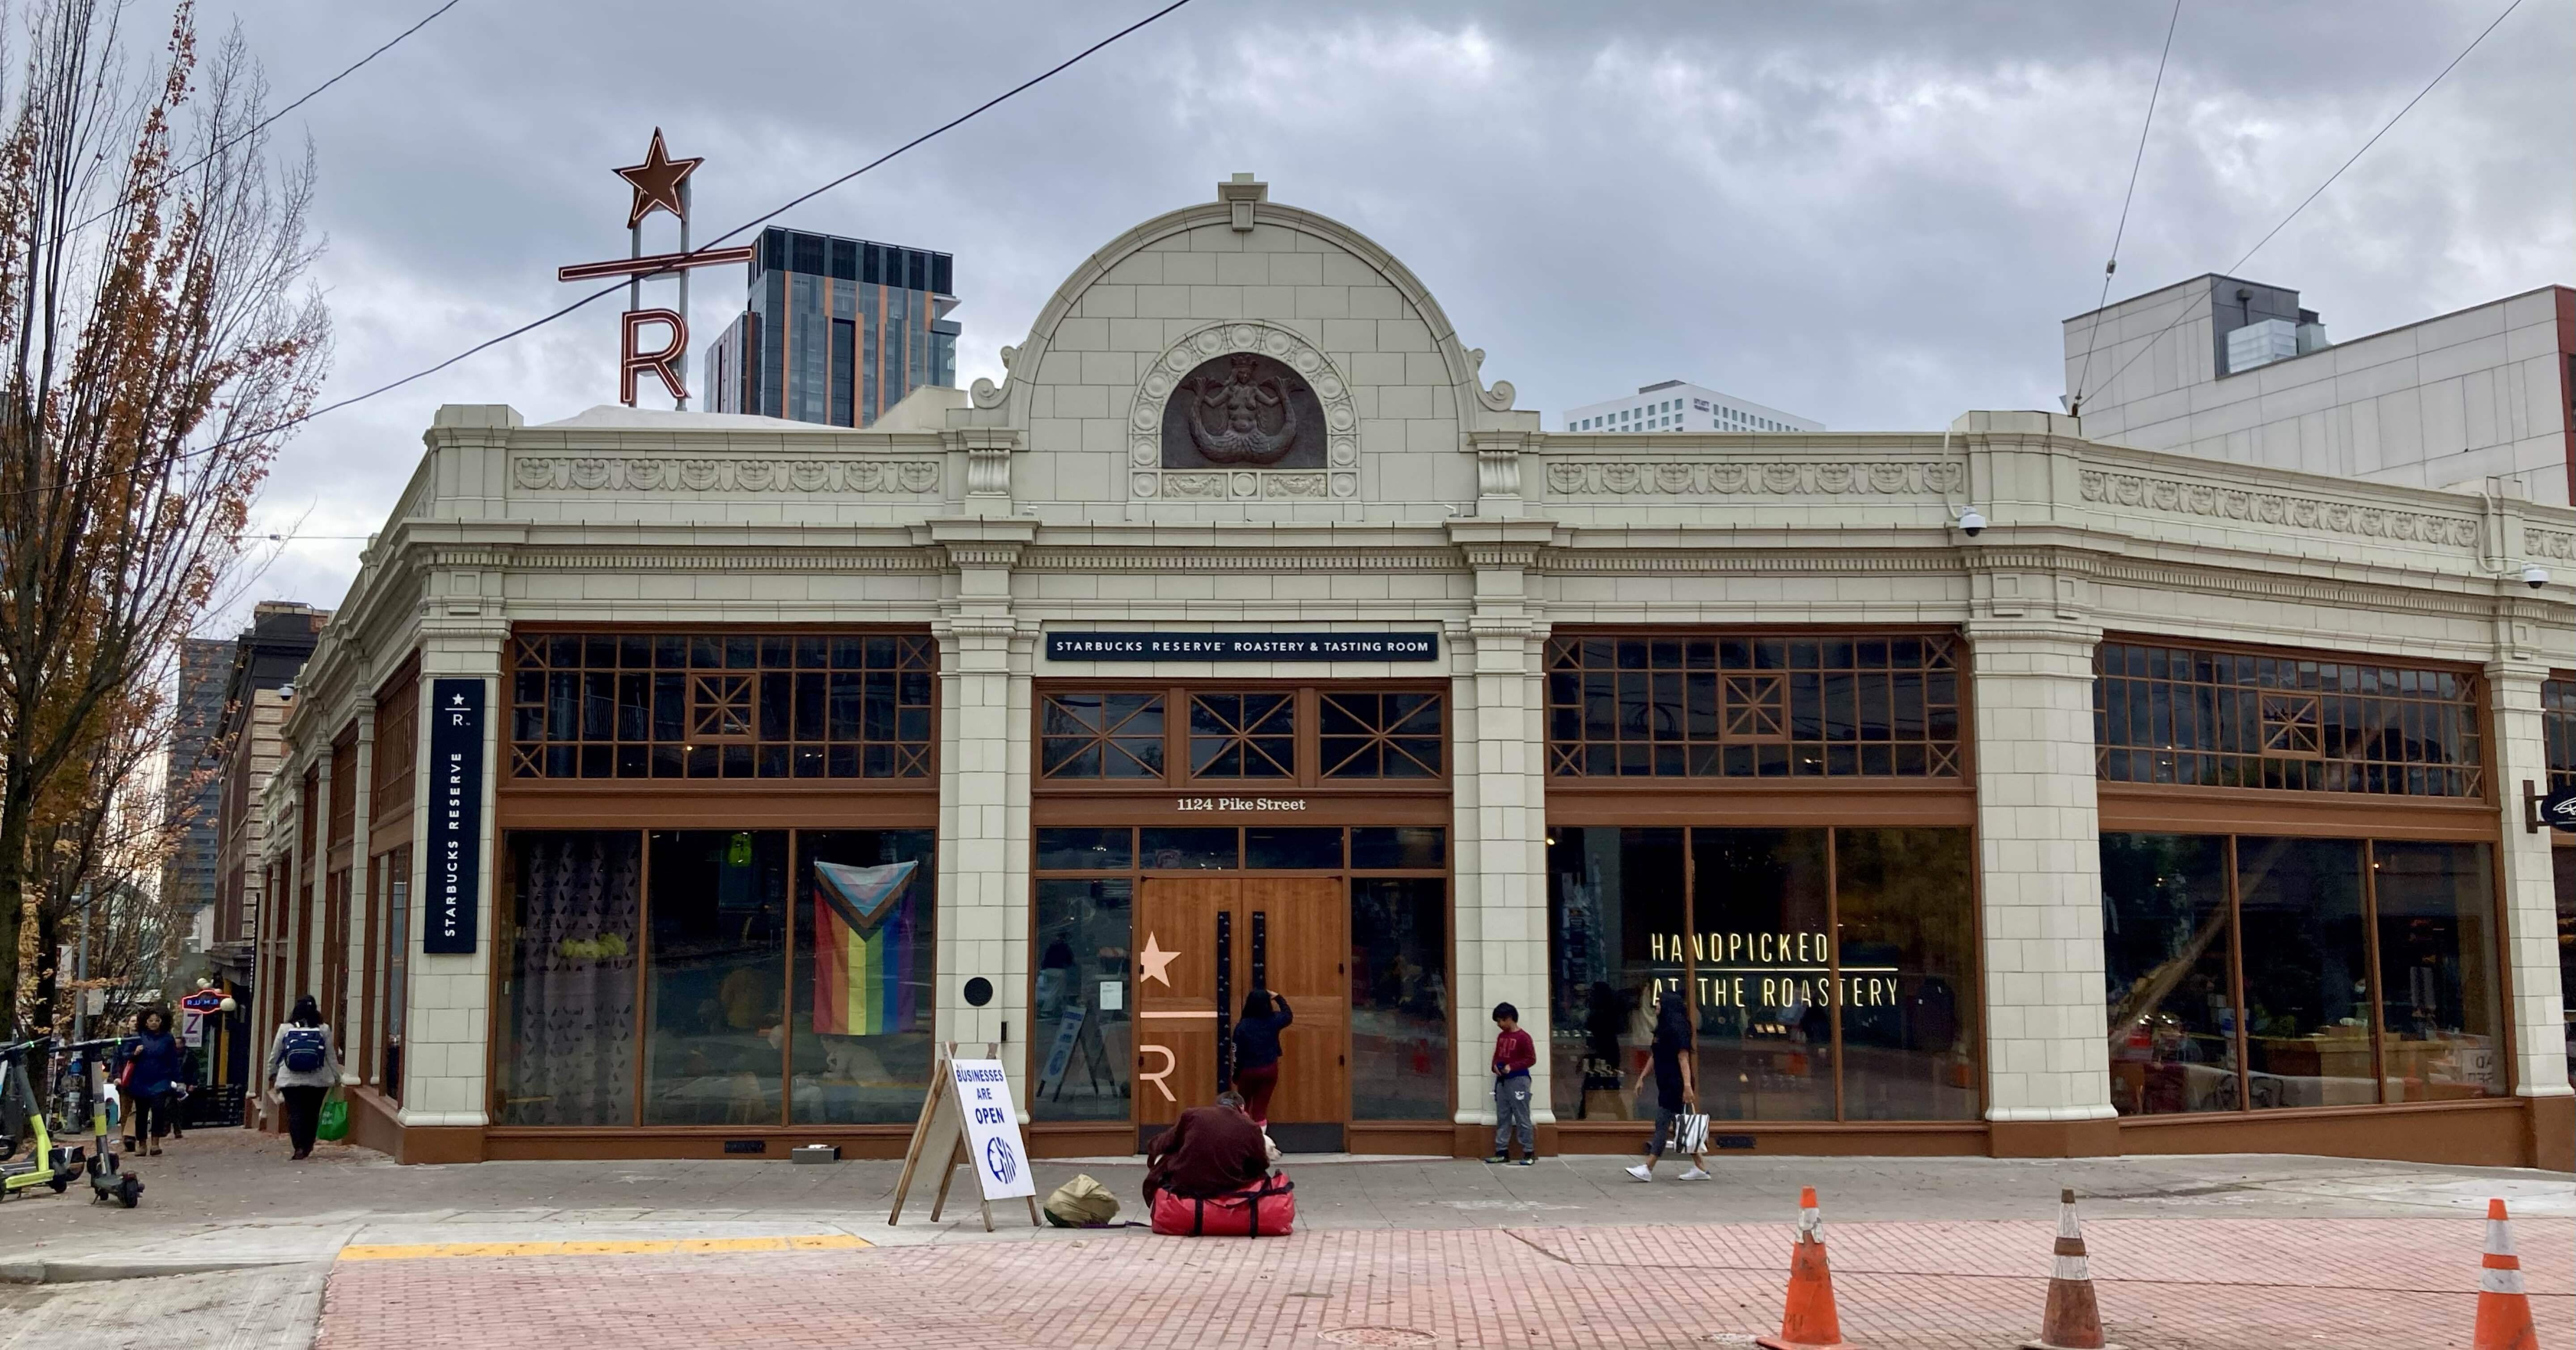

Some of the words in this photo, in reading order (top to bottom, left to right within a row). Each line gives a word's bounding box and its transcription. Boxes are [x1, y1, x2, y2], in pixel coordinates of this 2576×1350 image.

[621, 309, 691, 403] R
[1056, 642, 1143, 651] STARBUCKS
[1234, 642, 1304, 651] ROASTERY
[1310, 642, 1318, 651] &
[1324, 642, 1381, 651] TASTING
[1387, 642, 1428, 651] ROOM
[453, 714, 463, 726] R
[449, 753, 462, 829] RESERVE
[1177, 798, 1213, 810] 1124
[1219, 798, 1254, 810] Pike
[1257, 798, 1306, 810] Street
[445, 841, 459, 936] STARBUCKS
[1652, 933, 1827, 962] HANDPICKED
[1698, 978, 1745, 1007] THE
[1764, 978, 1897, 1007] ROASTERY
[957, 1070, 1003, 1082] BUSINESSES
[977, 1088, 992, 1100] ARE
[975, 1108, 1004, 1124] OPEN
